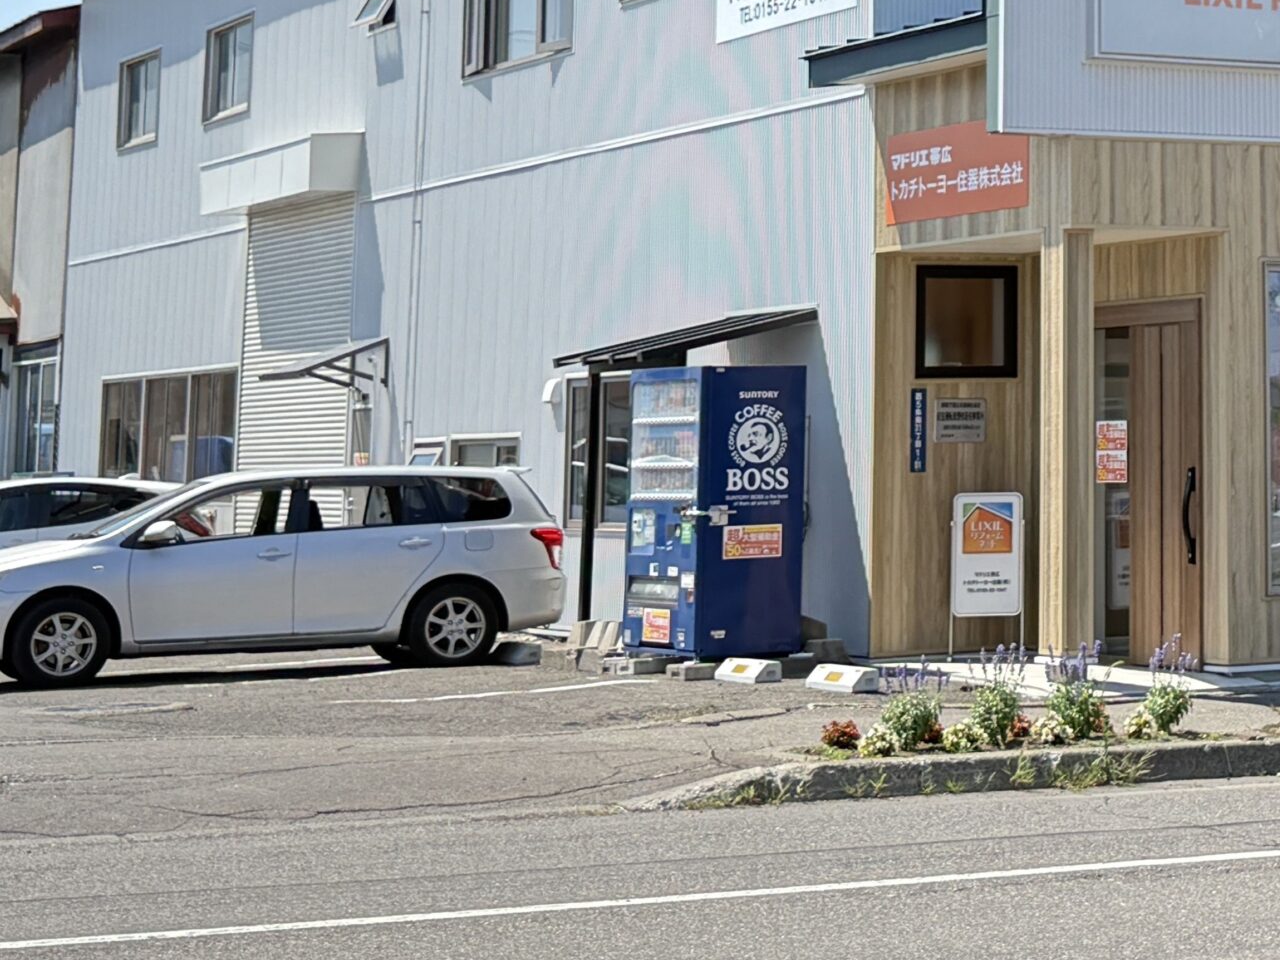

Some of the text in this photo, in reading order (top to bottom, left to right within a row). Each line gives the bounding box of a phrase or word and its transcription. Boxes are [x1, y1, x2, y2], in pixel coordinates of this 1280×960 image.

[891, 161, 1024, 201] トカチトーヨー住器株式会社
[739, 390, 780, 399] SUNTORY
[735, 404, 783, 423] COFFEE
[726, 467, 789, 491] BOSS
[970, 521, 1003, 531] LIXIL
